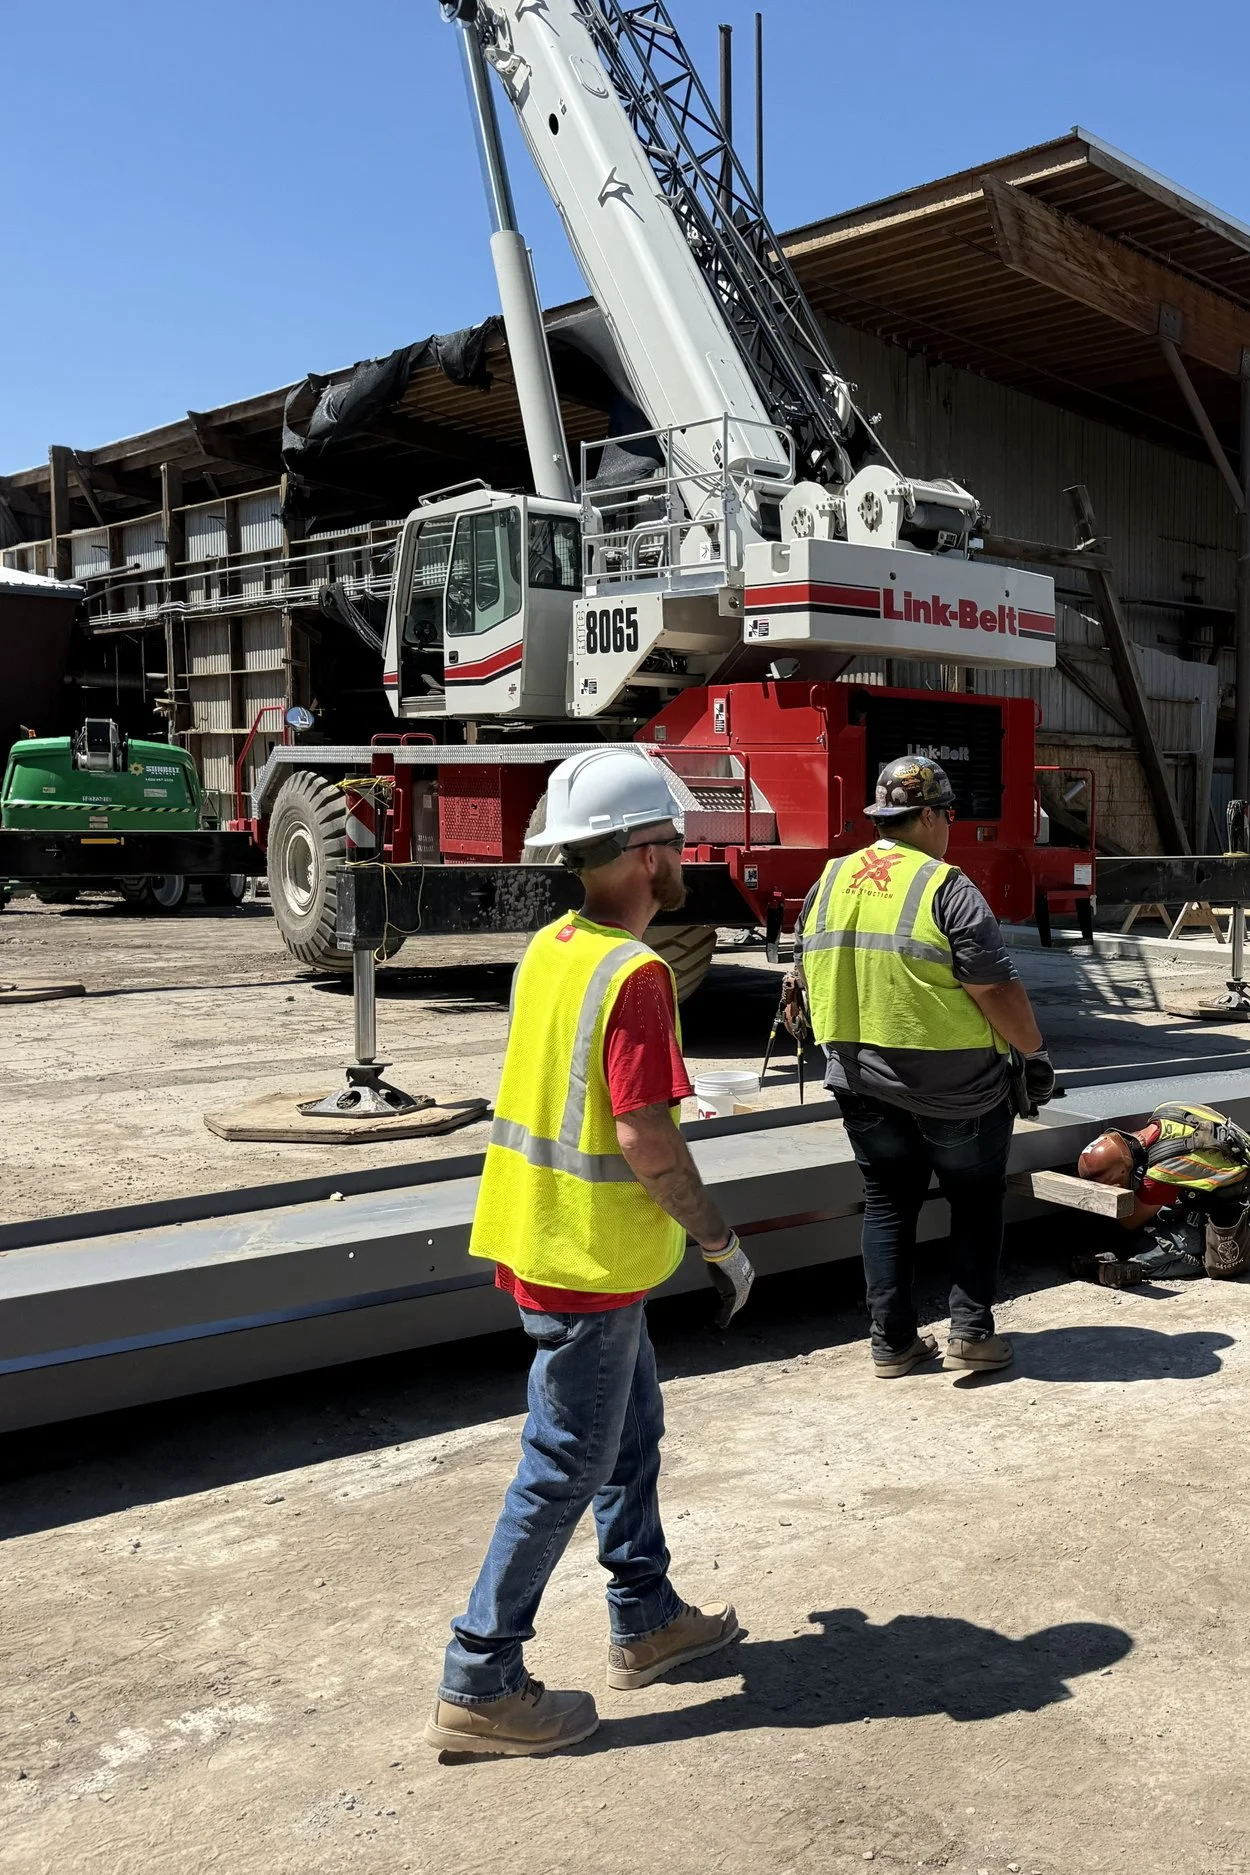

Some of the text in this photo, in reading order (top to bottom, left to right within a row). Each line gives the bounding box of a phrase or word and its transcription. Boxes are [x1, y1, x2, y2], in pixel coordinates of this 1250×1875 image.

[882, 587, 1018, 636] Link-Belt
[586, 606, 639, 655] 8065
[906, 743, 971, 761] Link-Belt
[145, 765, 181, 774] SUNBELT
